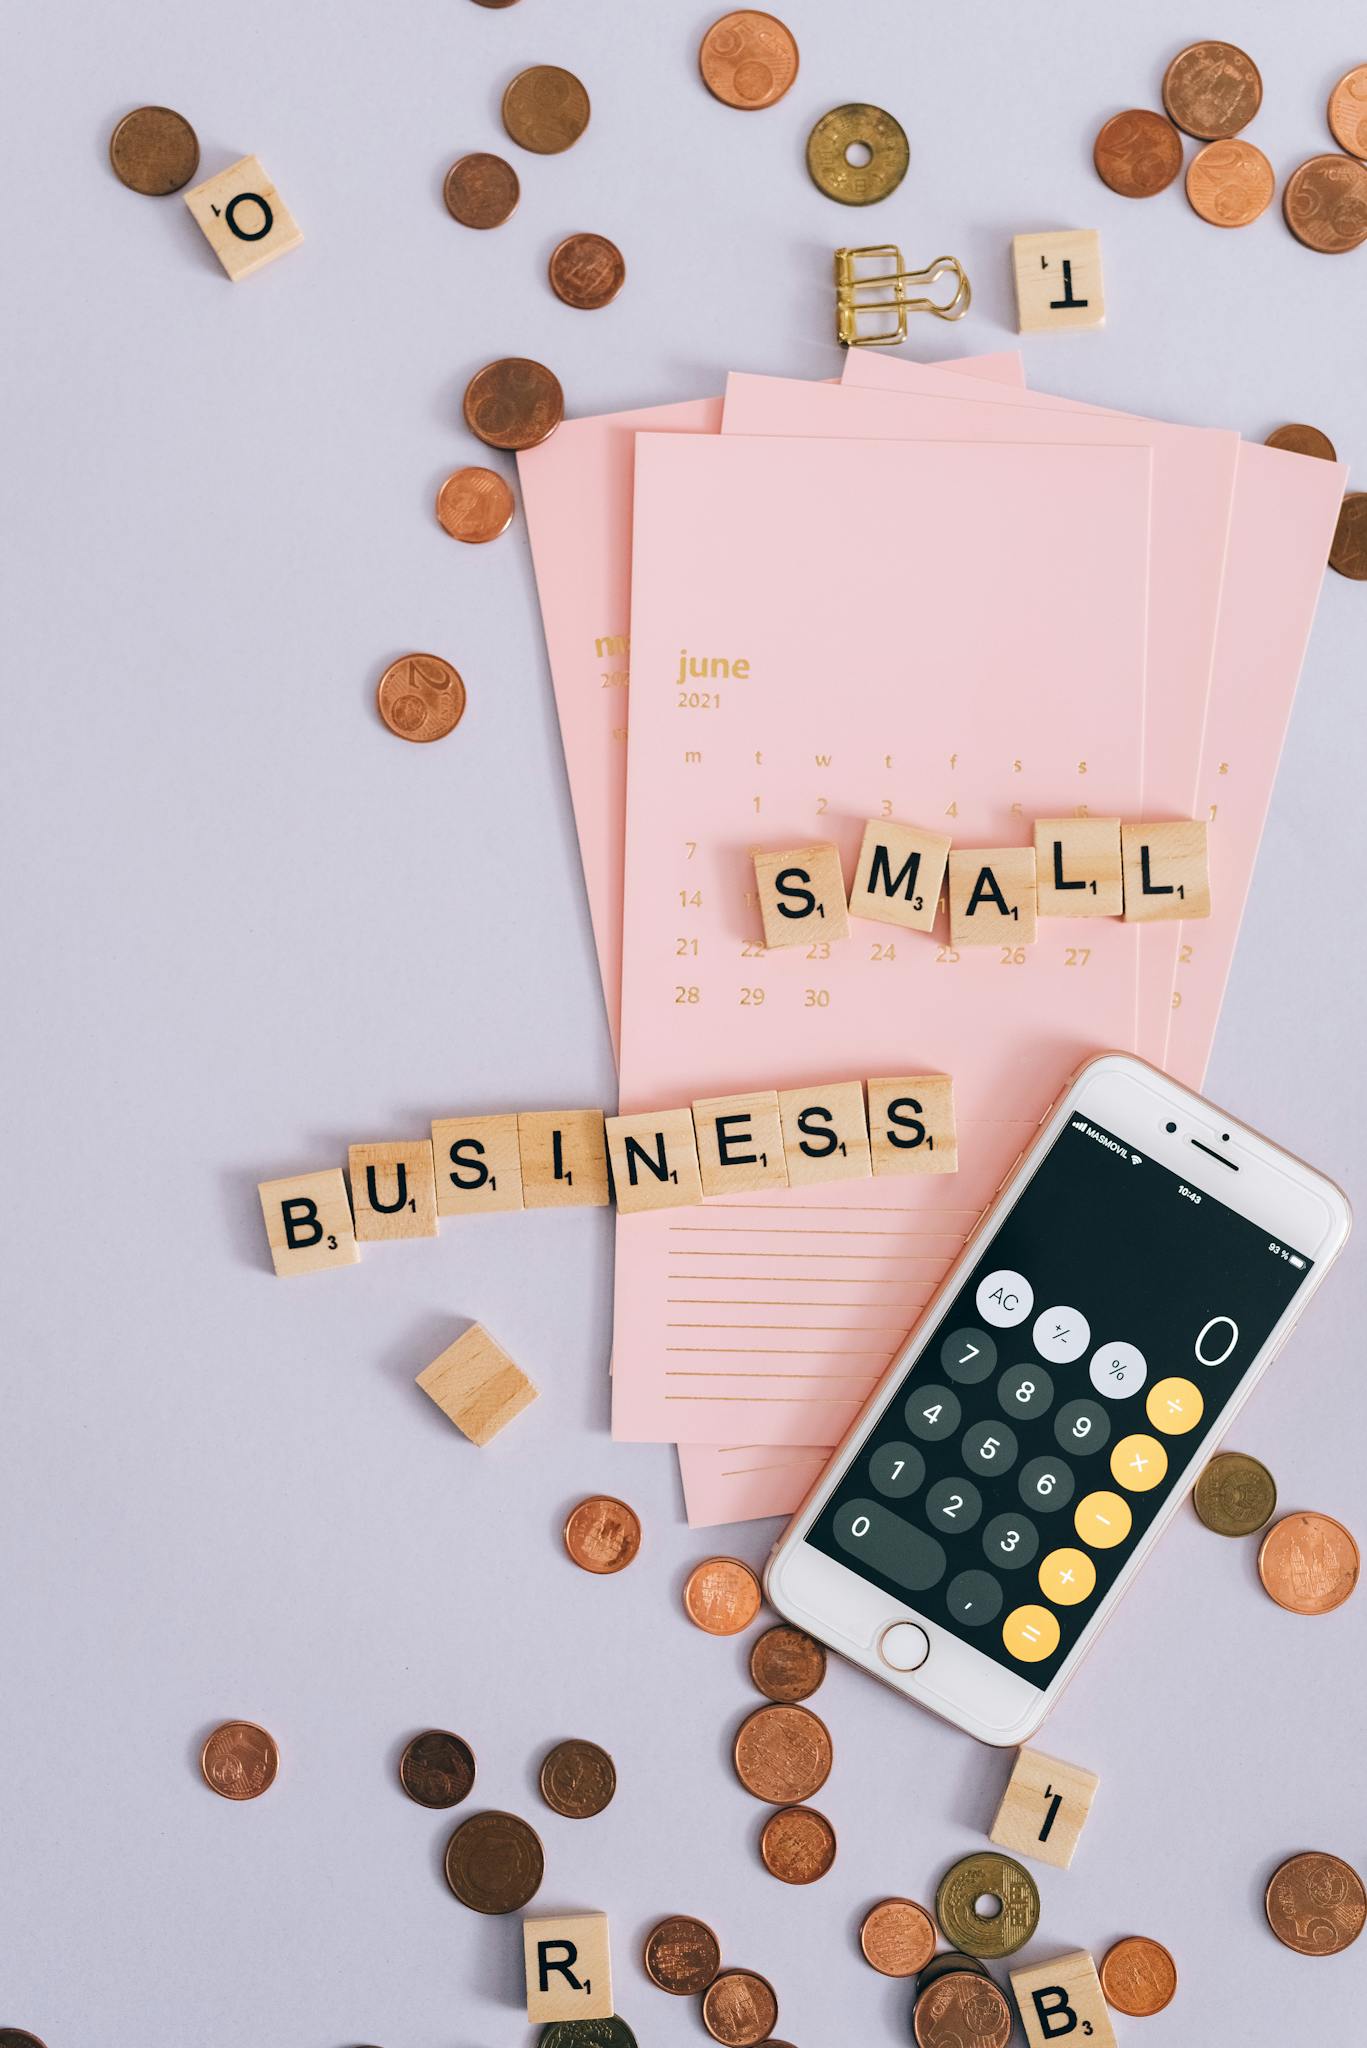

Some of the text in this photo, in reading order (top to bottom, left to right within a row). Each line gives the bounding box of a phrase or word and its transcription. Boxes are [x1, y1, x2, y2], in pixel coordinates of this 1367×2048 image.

[1051, 261, 1087, 308] T
[676, 649, 749, 685] june
[678, 692, 720, 708] 2021
[685, 750, 1087, 774] m t w t f s s
[1218, 763, 1229, 775] s
[753, 797, 761, 813] 1
[816, 798, 829, 815] 2
[881, 800, 893, 817] 3
[945, 802, 958, 818] 4
[685, 843, 697, 859] 7
[679, 890, 703, 908] 14
[676, 938, 698, 956] 21
[806, 943, 831, 960] 23
[870, 943, 896, 961] 24
[936, 946, 960, 963] 25
[1000, 947, 1026, 965] 26
[1064, 948, 1091, 966] 27
[675, 986, 830, 1007] 28 29 30
[1086, 1127, 1128, 1159] MASMOVIL
[1178, 1185, 1202, 1205] 10:43
[1268, 1243, 1290, 1261] 93 %
[988, 1287, 1019, 1311] AC
[1109, 1359, 1127, 1381] %
[1195, 1316, 1239, 1367] 0
[958, 1343, 980, 1364] 7
[1015, 1381, 1036, 1403] 8
[1072, 1417, 1092, 1438] 9
[923, 1404, 943, 1425] 4
[979, 1437, 1001, 1459] 5
[1036, 1474, 1057, 1495] 6
[891, 1461, 905, 1481] 1
[942, 1495, 964, 1518] 2
[1000, 1531, 1020, 1552] 3
[851, 1516, 870, 1537] 0
[538, 1940, 583, 1991] R
[1032, 1986, 1078, 2039] B
